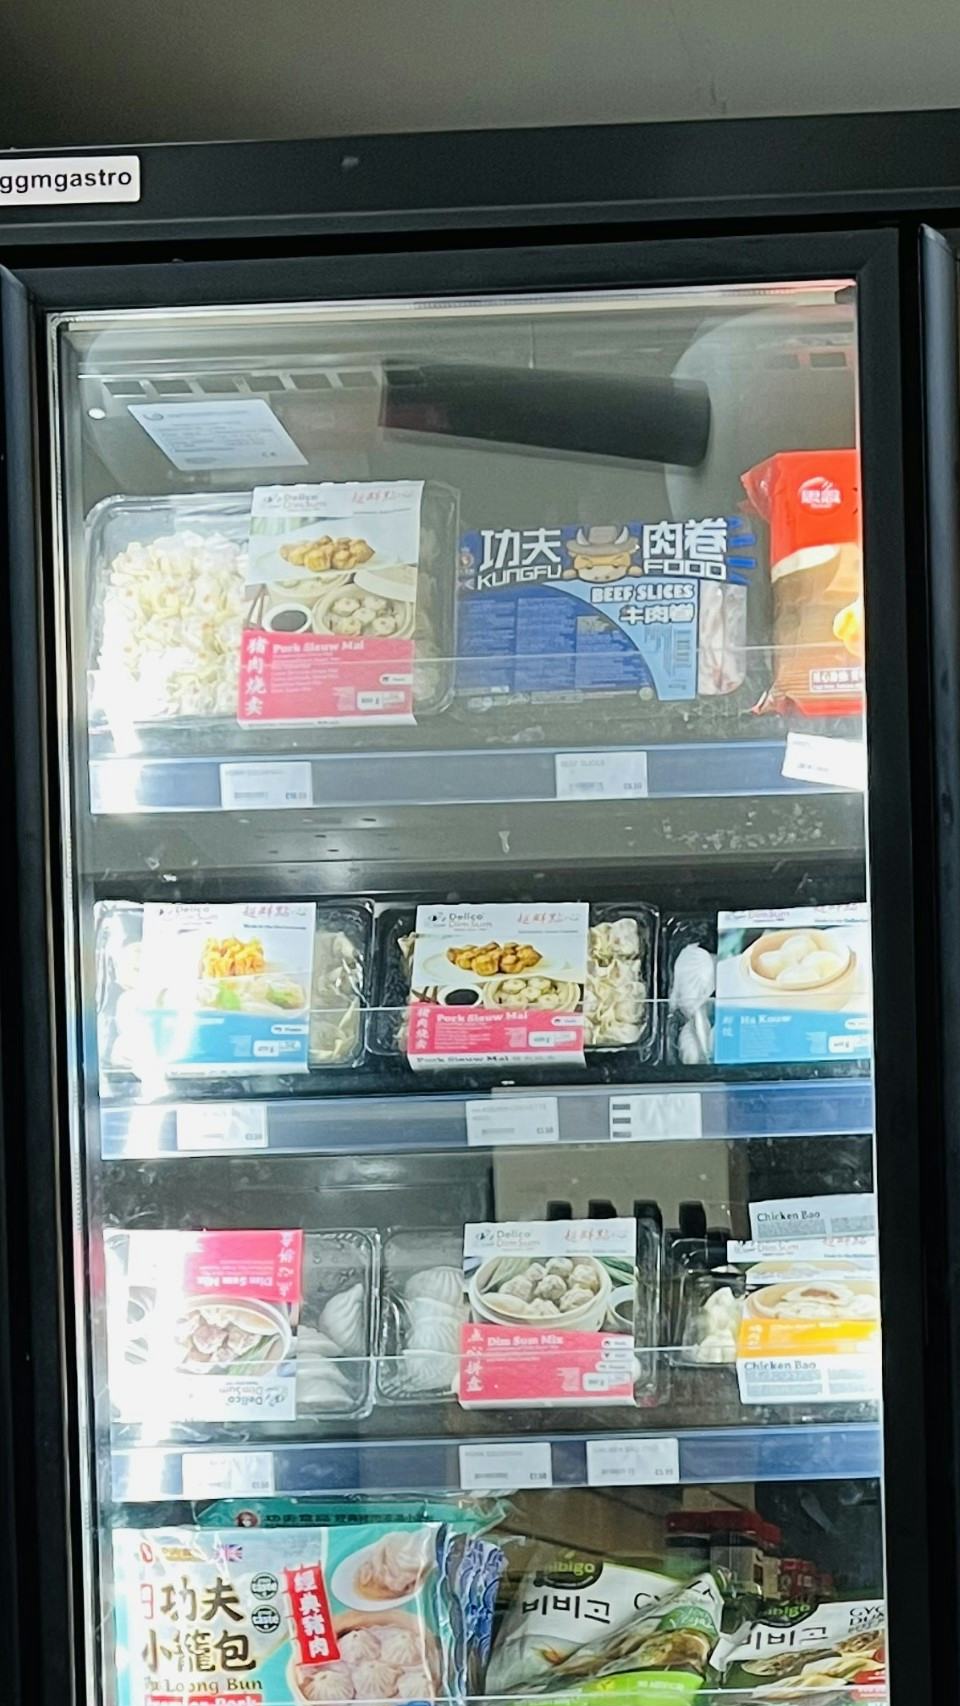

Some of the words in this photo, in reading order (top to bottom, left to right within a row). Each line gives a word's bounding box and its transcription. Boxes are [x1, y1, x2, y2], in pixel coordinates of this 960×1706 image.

[0, 169, 132, 193] ggmgastro
[480, 527, 562, 571] 功夫
[643, 517, 727, 560] 肉卷
[477, 564, 562, 590] KUNGFU
[644, 560, 727, 580] FOOD
[591, 585, 633, 603] BEEF
[636, 583, 694, 601] SLICES
[273, 643, 301, 653] Pork
[449, 913, 484, 921] Delico
[437, 1014, 465, 1023] Pork
[505, 1011, 528, 1020] Mai
[757, 1211, 799, 1222] Chicken
[802, 1210, 820, 1220] Bao
[487, 1337, 511, 1346] Dim
[513, 1336, 538, 1346] Sum
[541, 1335, 564, 1345] Mix
[744, 1361, 792, 1371] Chicken
[794, 1360, 816, 1369] Bao
[160, 1576, 244, 1622] 功夫
[522, 1595, 610, 1624] 비비고
[227, 1678, 263, 1690] Bun
